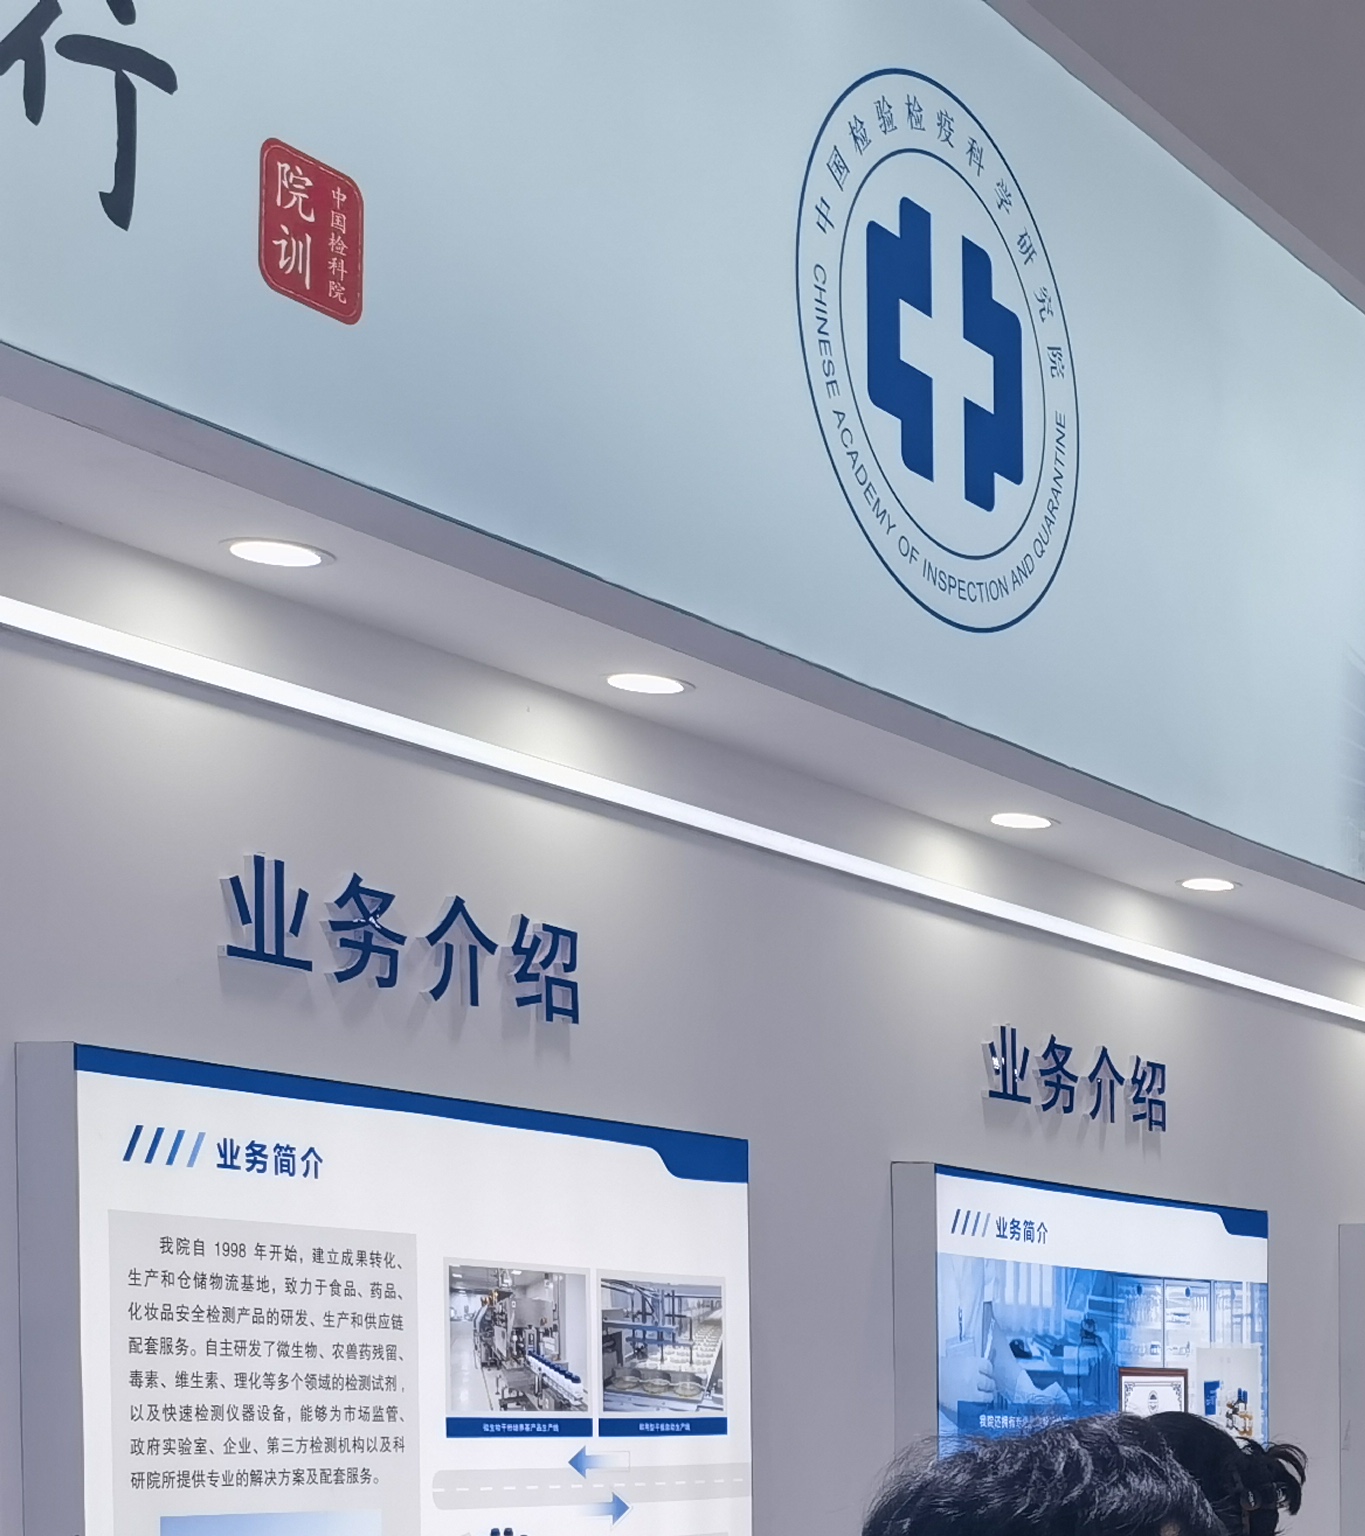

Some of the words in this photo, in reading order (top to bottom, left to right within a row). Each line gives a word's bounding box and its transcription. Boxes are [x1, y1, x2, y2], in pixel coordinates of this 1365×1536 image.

[272, 161, 315, 290] 院训
[328, 187, 348, 305] 中国检科院
[813, 94, 1066, 381] 中国检验检疫科学研究院
[812, 263, 841, 398] CHINESE
[832, 407, 898, 536] ACADEMY
[897, 536, 920, 565] OF
[921, 558, 1010, 604] INSPECTION
[1010, 553, 1036, 593] AND
[1033, 410, 1067, 559] QUARANTINE
[222, 854, 581, 1025] 业务介绍
[986, 1025, 1168, 1132] 业务介绍
[215, 1137, 324, 1180] 业务简介
[159, 1236, 206, 1257] 我院自
[214, 1242, 247, 1258] 1998
[254, 1244, 403, 1270] 年开始，建立成果转化、
[996, 1216, 1049, 1245] 业务简介
[128, 1302, 404, 1331] 化妆品安全检测产品的研发、生产和供应链
[130, 1436, 405, 1456] 政府实验室、企业、第三方检测机构以及科
[130, 1467, 379, 1489] 研院所提供专业的解决方案及配套服务。
